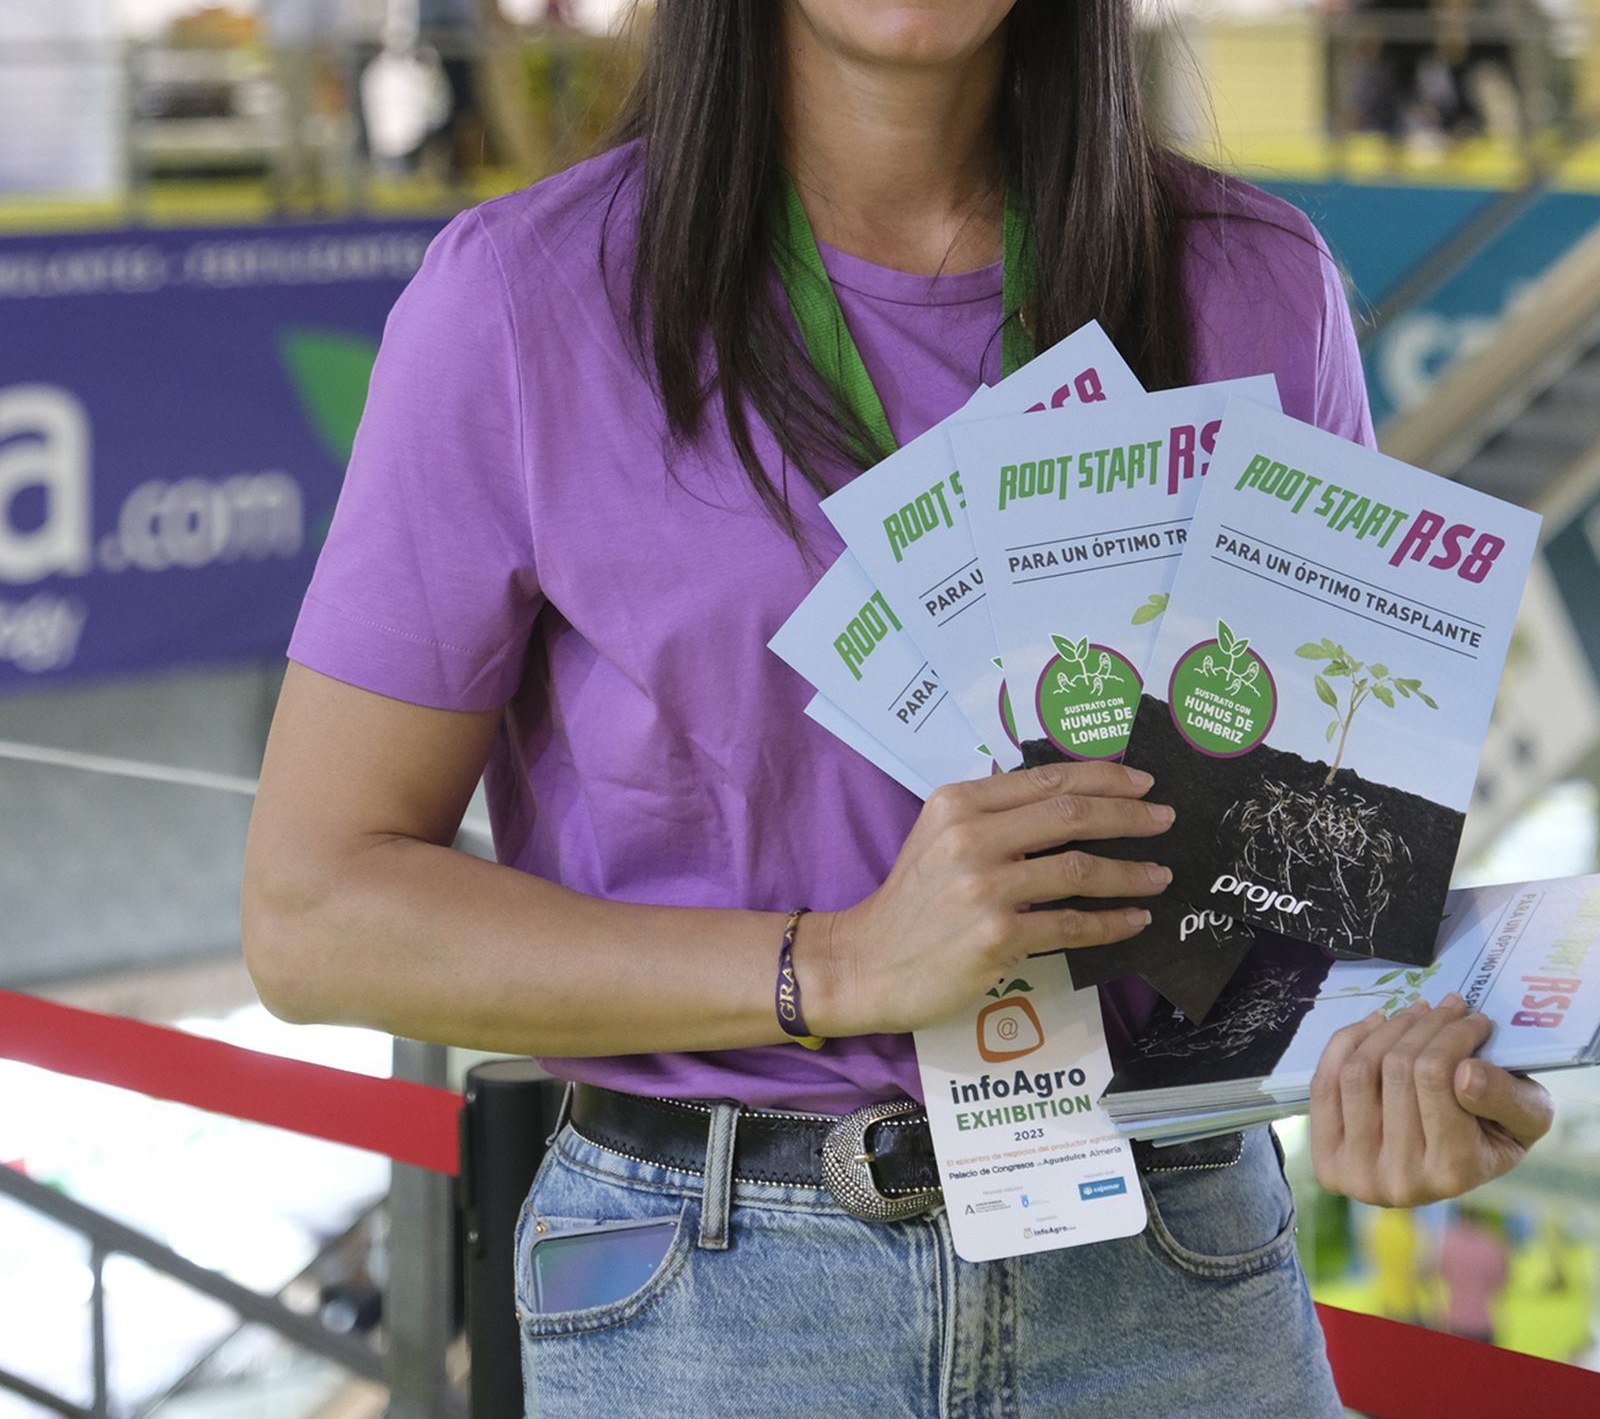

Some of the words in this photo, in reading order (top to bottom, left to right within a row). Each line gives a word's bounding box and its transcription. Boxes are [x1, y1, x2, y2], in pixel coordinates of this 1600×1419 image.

[998, 455, 1072, 511] ROOT
[1078, 440, 1162, 494] START
[882, 480, 954, 563] ROOT
[1234, 453, 1323, 514] ROOT
[1313, 484, 1409, 548] START
[1388, 509, 1506, 584] RS8
[1008, 551, 1058, 573] PARA
[1061, 544, 1088, 562] UN
[1092, 532, 1161, 558] ÓPTIMO
[924, 579, 973, 617] PARA
[1215, 533, 1261, 565] PARA
[1265, 553, 1291, 576] UN
[1294, 562, 1361, 603] ÓPTIMO
[1365, 592, 1482, 648] TRASPLANTE
[833, 589, 903, 681] ROOT
[896, 679, 938, 725] PARA
[1060, 712, 1111, 731] HUMUS
[1114, 706, 1133, 720] DE
[1064, 701, 1106, 715] SUSTRATO
[1107, 697, 1125, 707] CON
[1184, 695, 1232, 724] HUMUS
[1235, 717, 1254, 732] DE
[1194, 687, 1233, 709] SUSTRATO
[1234, 702, 1251, 715] CON
[1071, 723, 1131, 745] LOMBRIZ
[1186, 712, 1244, 744] LOMBRIZ
[1210, 874, 1313, 915] projar
[1511, 975, 1582, 1028] RS8
[950, 1067, 1086, 1104] infoAgro
[956, 1094, 1092, 1132] EXHIBITION
[1014, 1128, 1045, 1142] 2023
[1051, 1139, 1088, 1152] productor
[949, 1170, 979, 1180] Palacio
[980, 1166, 991, 1176] de
[992, 1161, 1035, 1174] Congresos
[1043, 1153, 1087, 1166] Aguadulce
[1089, 1145, 1122, 1158] Almería
